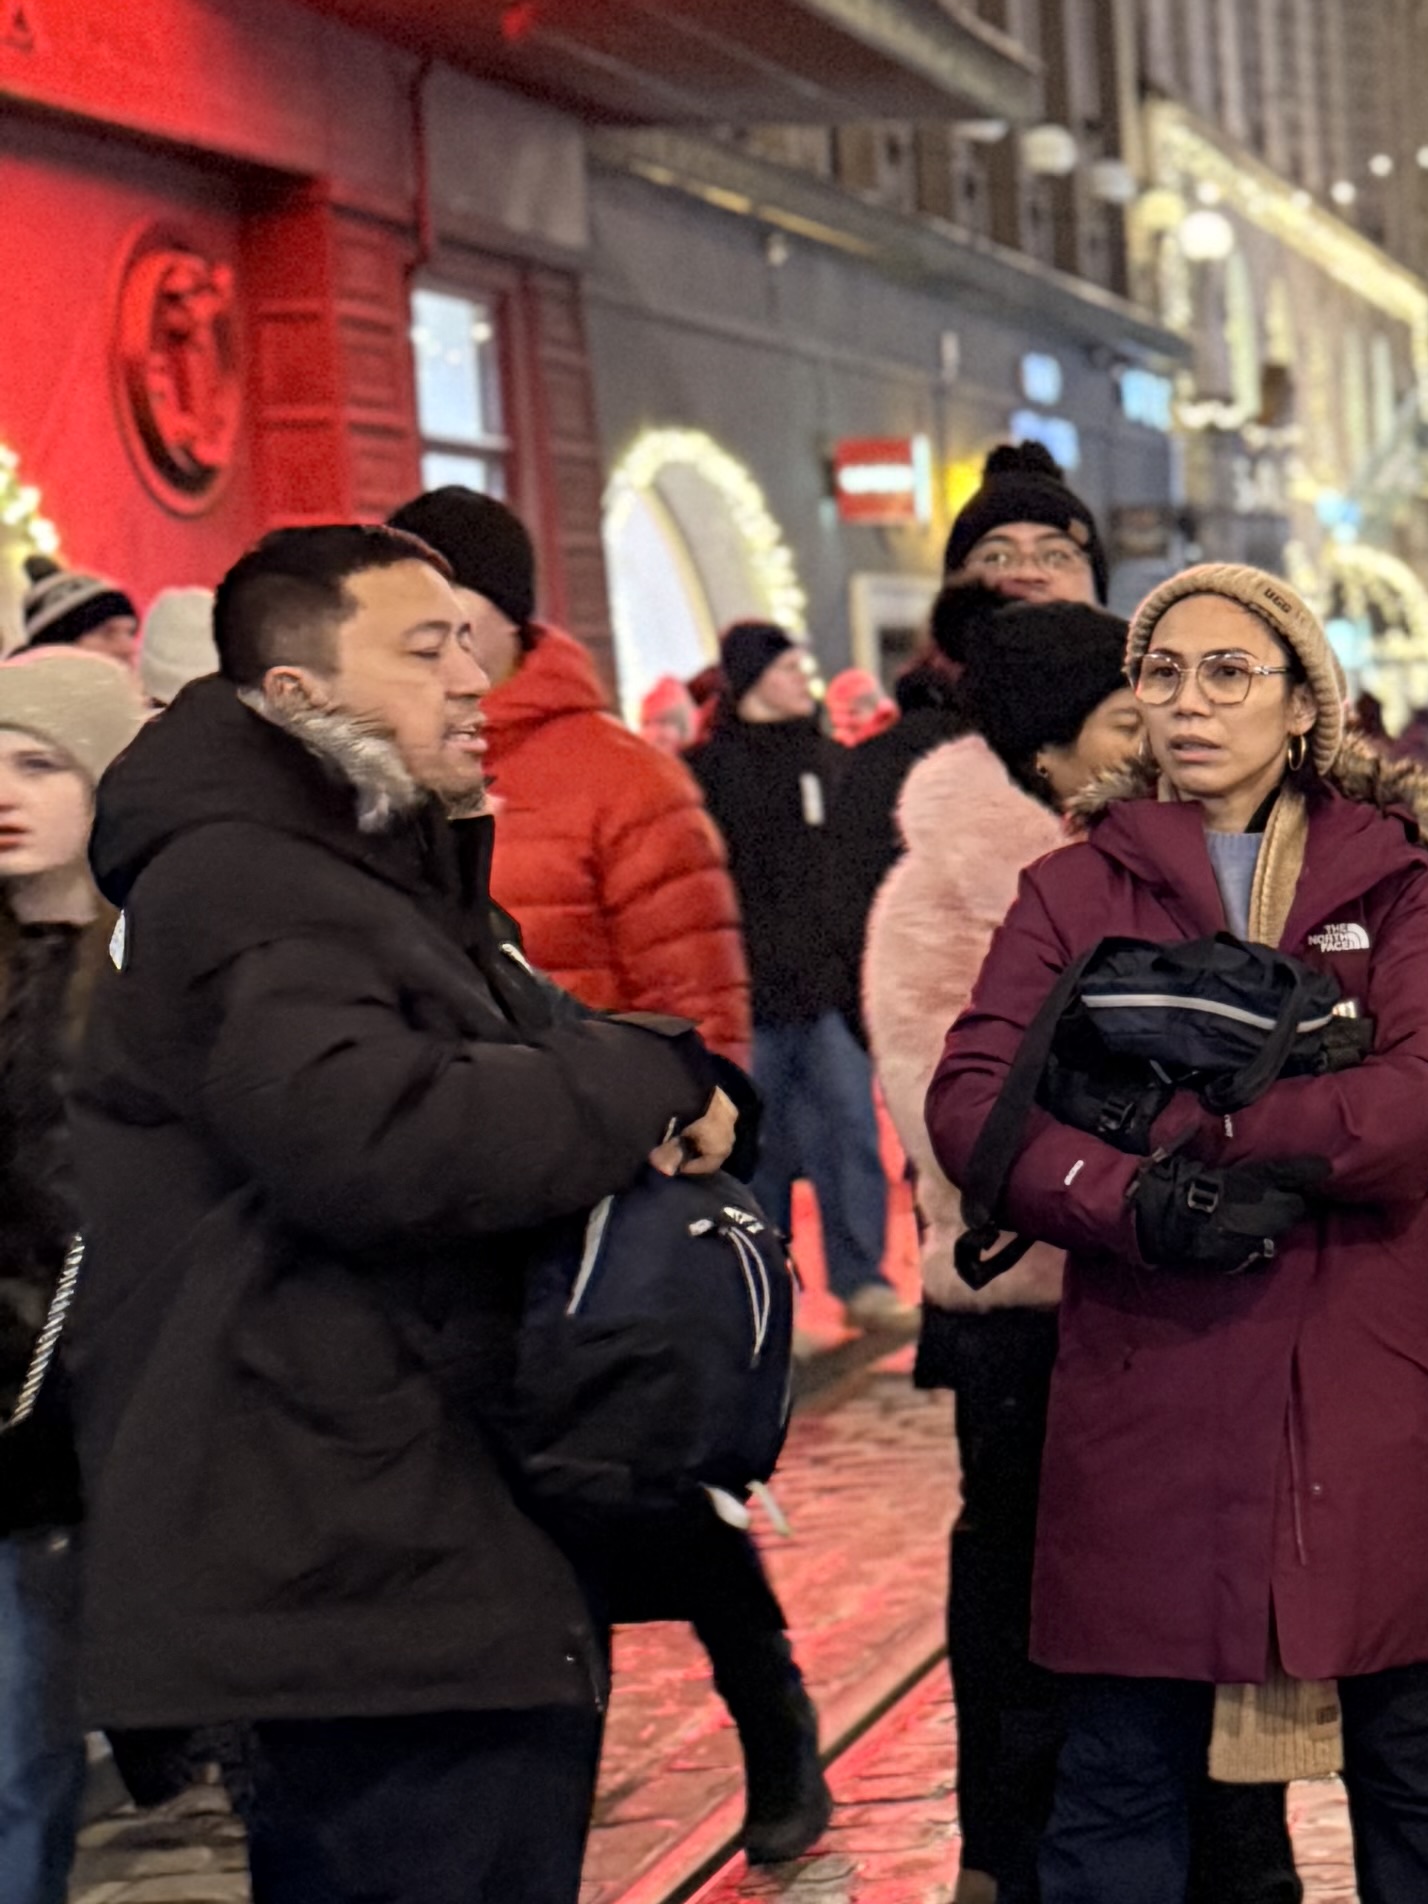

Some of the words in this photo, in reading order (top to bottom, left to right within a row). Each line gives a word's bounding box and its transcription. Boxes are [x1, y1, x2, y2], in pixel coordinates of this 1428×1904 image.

[1264, 587, 1292, 614] UGG
[1323, 923, 1347, 935] THE
[1307, 932, 1348, 946] NORTH
[1320, 941, 1350, 953] FACE
